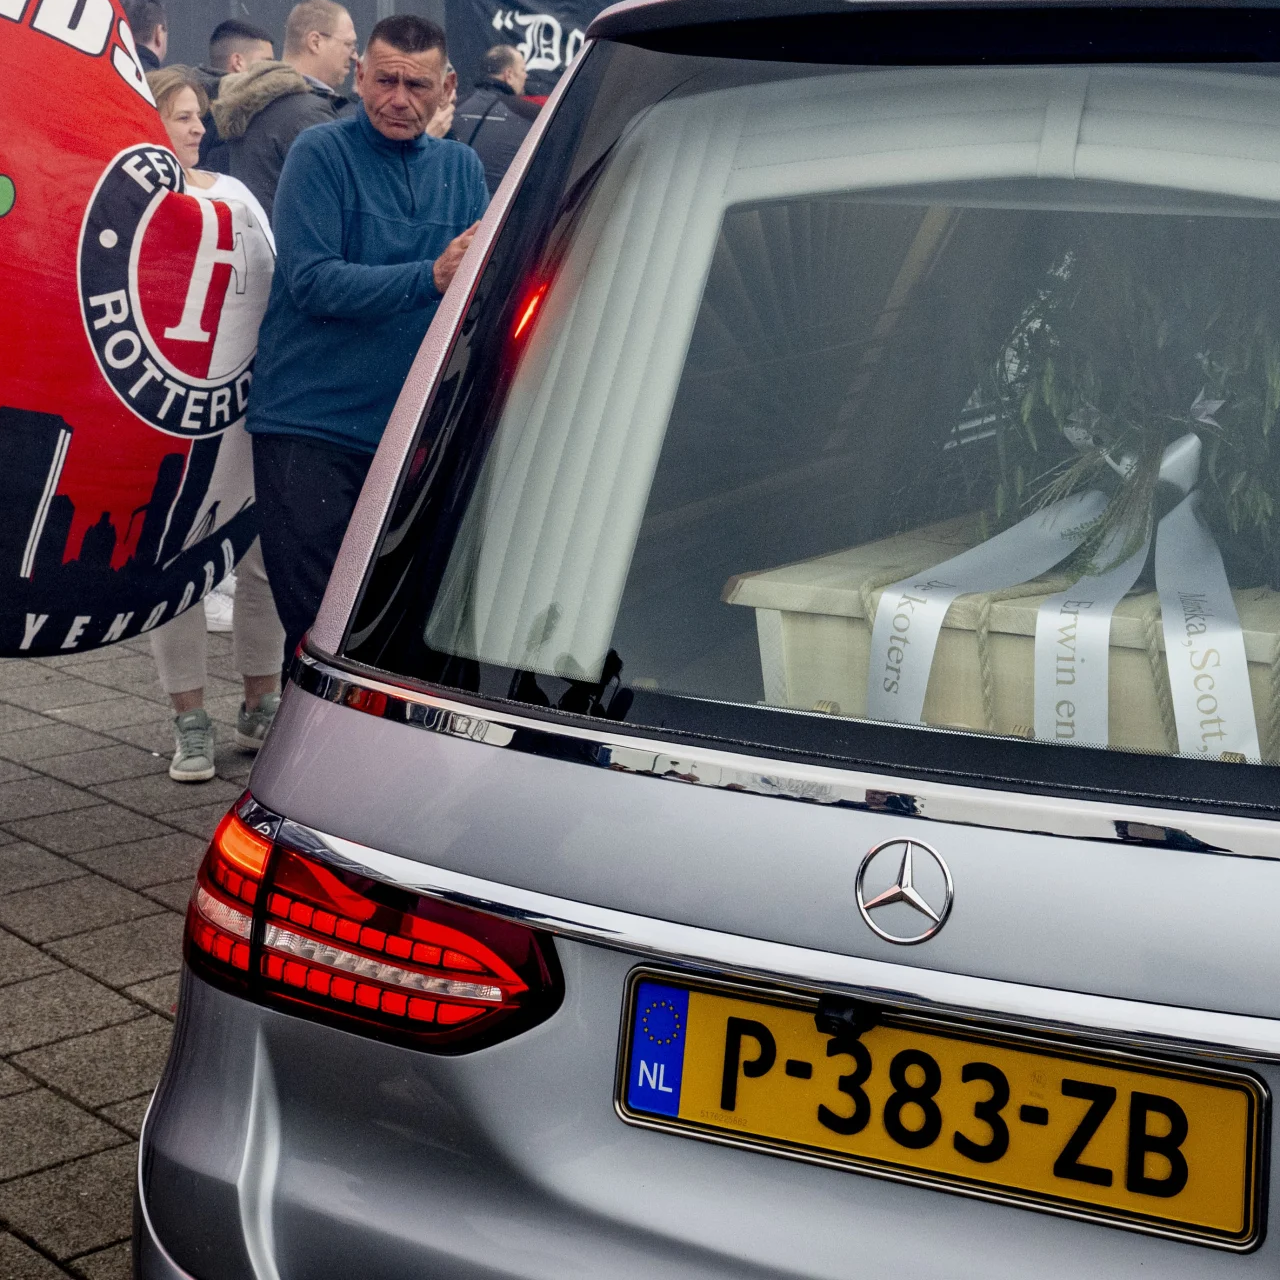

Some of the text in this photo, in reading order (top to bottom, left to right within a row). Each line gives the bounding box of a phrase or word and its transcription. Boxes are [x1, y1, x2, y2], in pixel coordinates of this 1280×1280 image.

[882, 592, 928, 695] koters
[1055, 599, 1095, 740] Erwin en
[1189, 647, 1229, 754] Scott,
[638, 1058, 674, 1095] NL
[720, 1016, 1190, 1199] P-383-ZB
